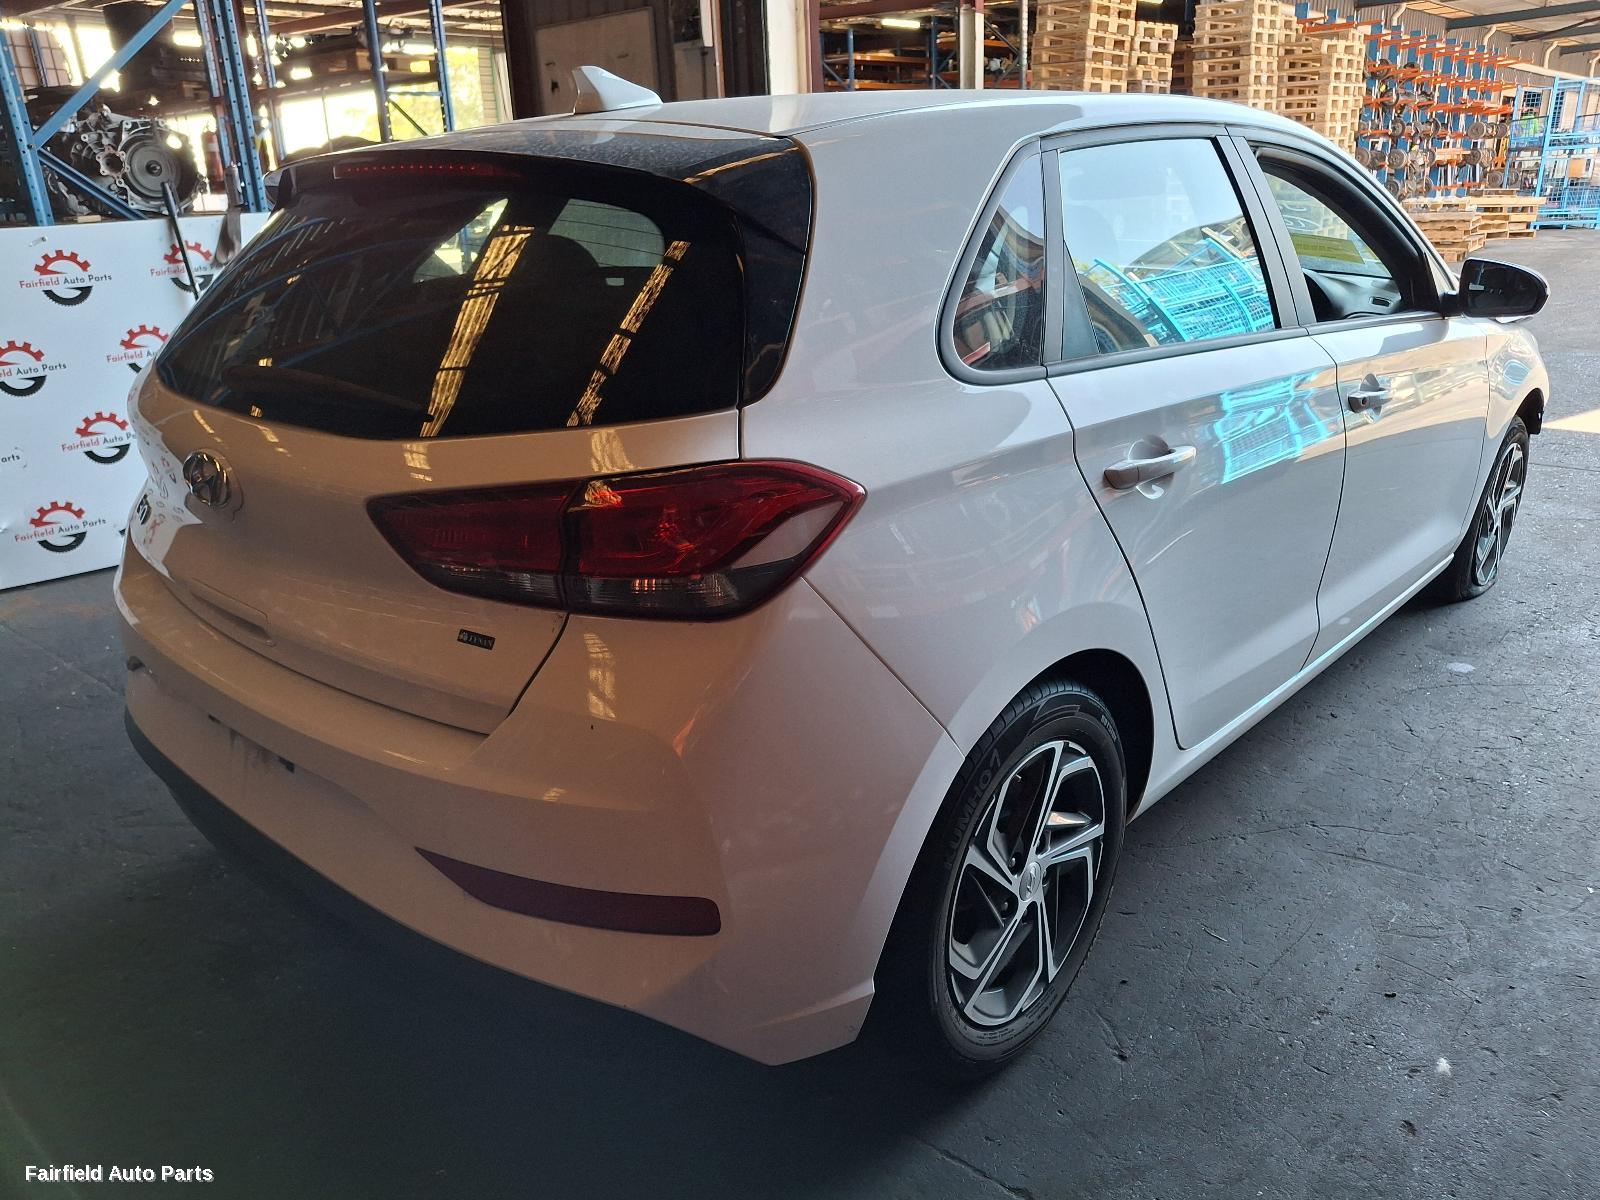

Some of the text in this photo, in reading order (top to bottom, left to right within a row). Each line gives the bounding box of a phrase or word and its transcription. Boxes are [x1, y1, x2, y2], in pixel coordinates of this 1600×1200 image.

[19, 274, 112, 289] Fairfield Auto Parts
[16, 367, 39, 376] Auto
[41, 363, 67, 371] Parts
[61, 438, 100, 452] Fairfield
[103, 435, 123, 445] Auto
[15, 518, 106, 542] Fairfield Auto Parts
